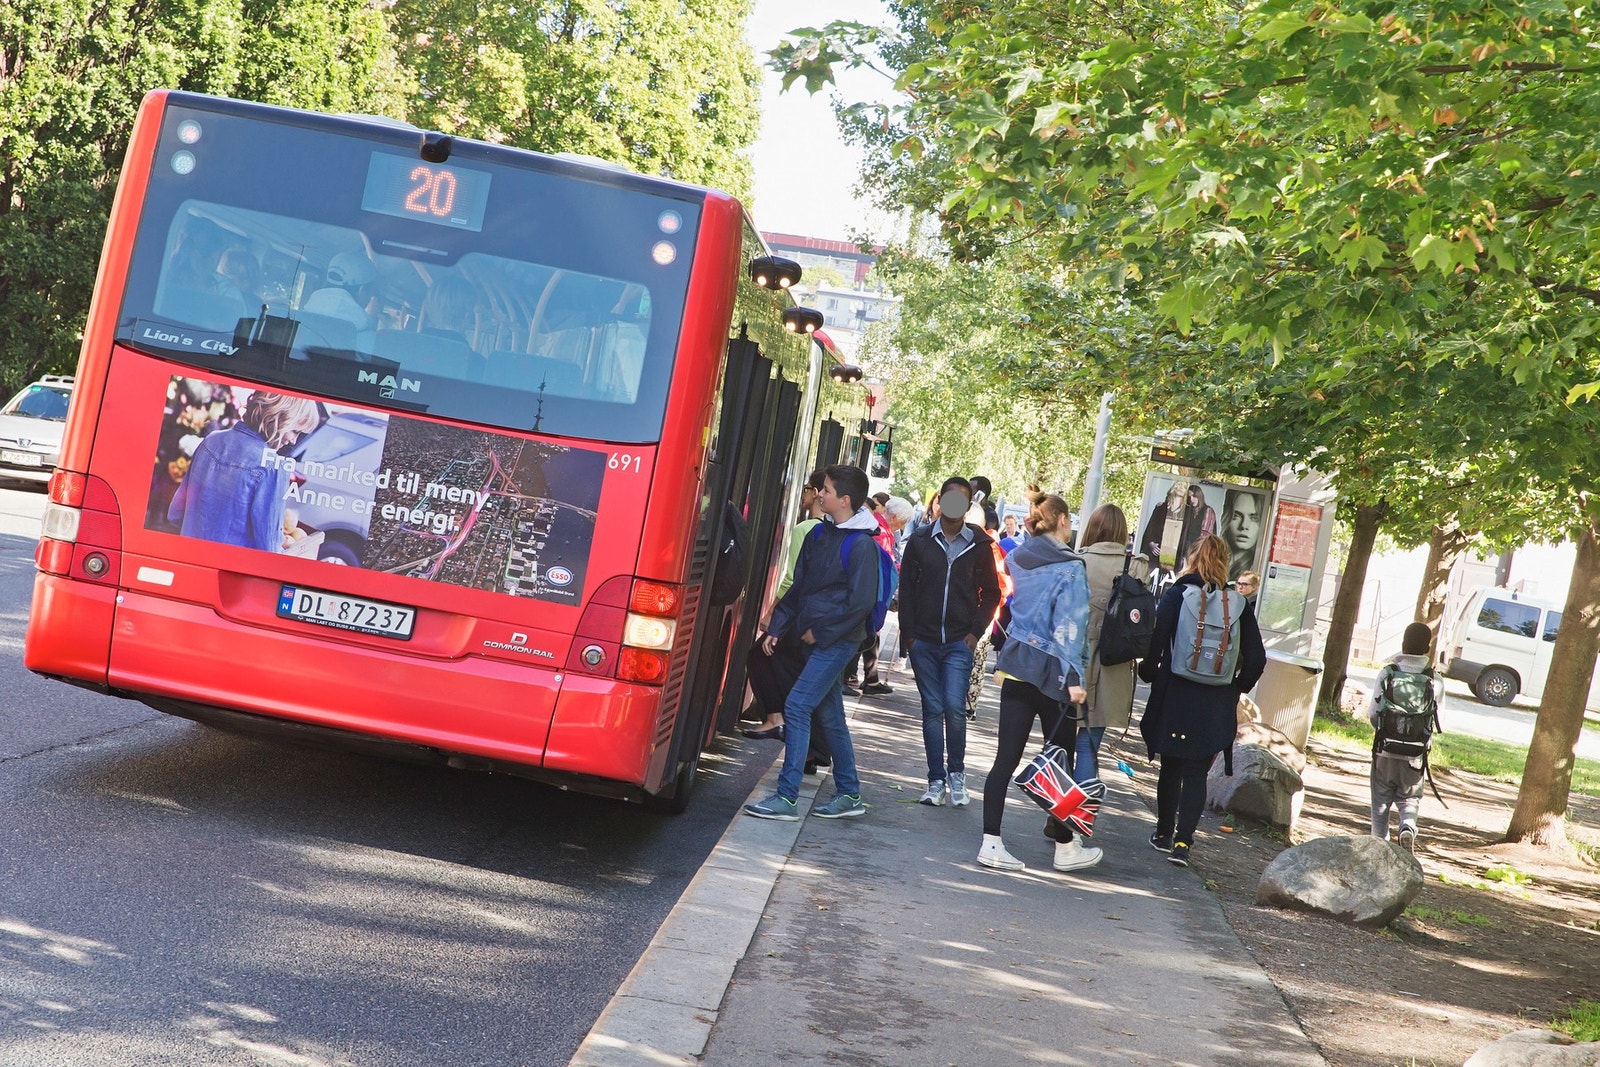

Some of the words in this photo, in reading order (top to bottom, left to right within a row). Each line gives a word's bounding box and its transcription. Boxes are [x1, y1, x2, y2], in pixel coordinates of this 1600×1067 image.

[404, 166, 456, 216] 20
[143, 327, 193, 346] Lion's
[200, 339, 240, 356] City
[357, 369, 421, 393] MAN
[608, 452, 641, 474] 691
[260, 447, 297, 473] Fra
[302, 459, 391, 490] marked
[396, 472, 420, 496] til
[425, 482, 493, 513] meny.
[281, 481, 346, 510] Anne
[350, 499, 377, 516] er
[380, 504, 460, 534] energi.
[298, 594, 325, 617] DL
[337, 601, 408, 631] 87237
[483, 640, 532, 654] COMMON
[532, 649, 555, 659] RAIL
